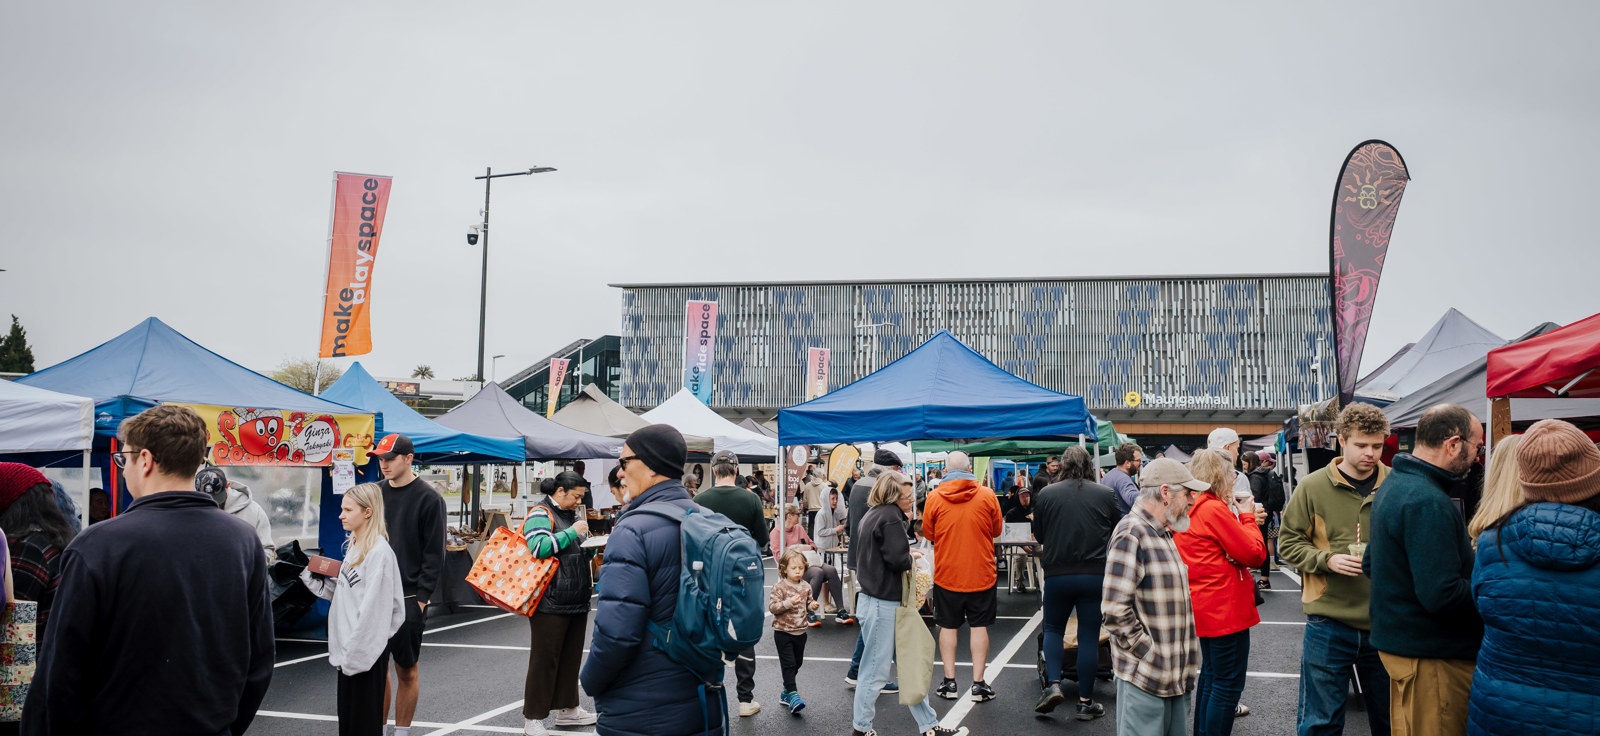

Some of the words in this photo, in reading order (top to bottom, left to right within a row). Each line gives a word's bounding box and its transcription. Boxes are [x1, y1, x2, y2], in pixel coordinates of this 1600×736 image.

[350, 178, 379, 305] playspace
[332, 288, 354, 358] make
[697, 303, 710, 372] ridespace
[1145, 393, 1229, 406] Maungawhau
[304, 425, 331, 442] Ginza
[304, 439, 332, 451] Takoyaki
